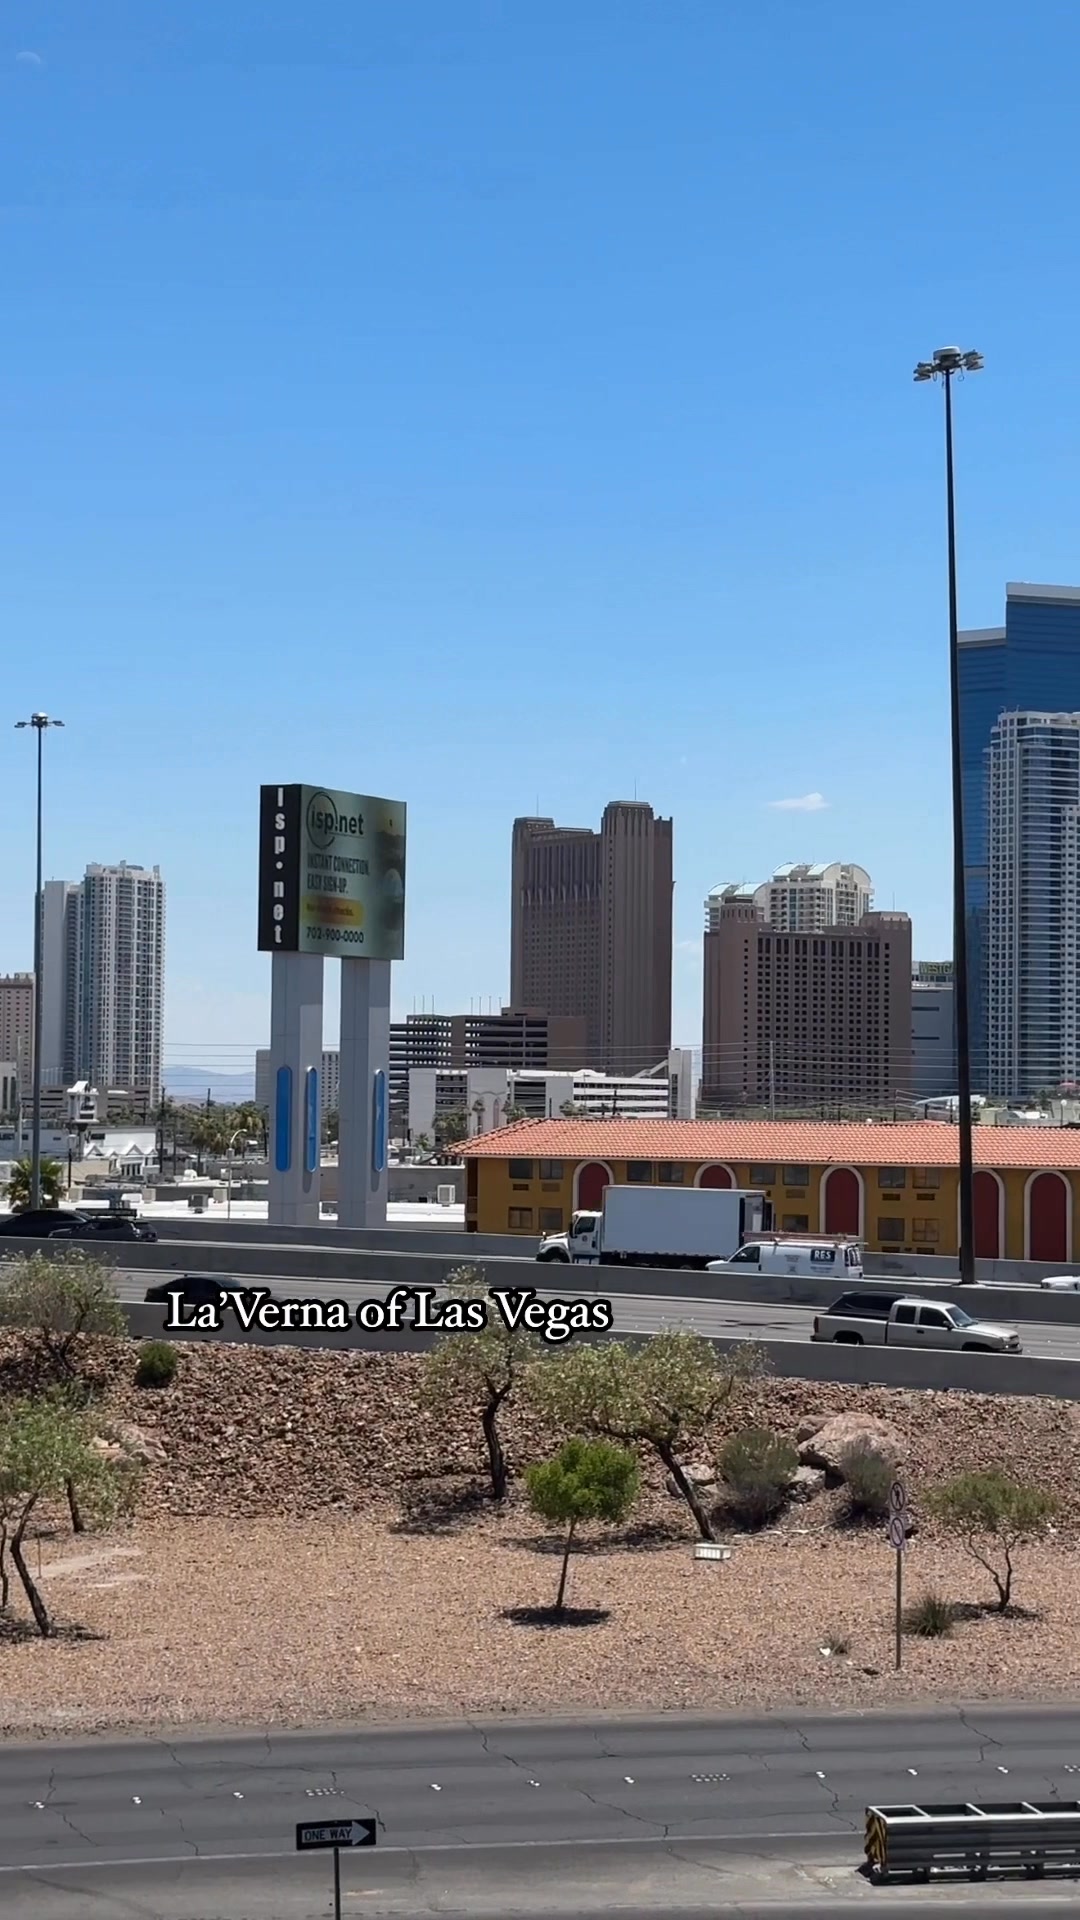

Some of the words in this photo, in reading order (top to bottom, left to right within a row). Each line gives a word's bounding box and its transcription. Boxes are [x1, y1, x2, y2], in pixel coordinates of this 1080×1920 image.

[311, 804, 364, 835] isp.net
[307, 852, 333, 870] INSTANT
[307, 873, 322, 890] EASY
[306, 926, 364, 943] 702-900-0000
[919, 962, 953, 974] WESTG
[814, 1250, 832, 1260] RES
[304, 1830, 325, 1841] ONE
[329, 1828, 352, 1839] WAY
